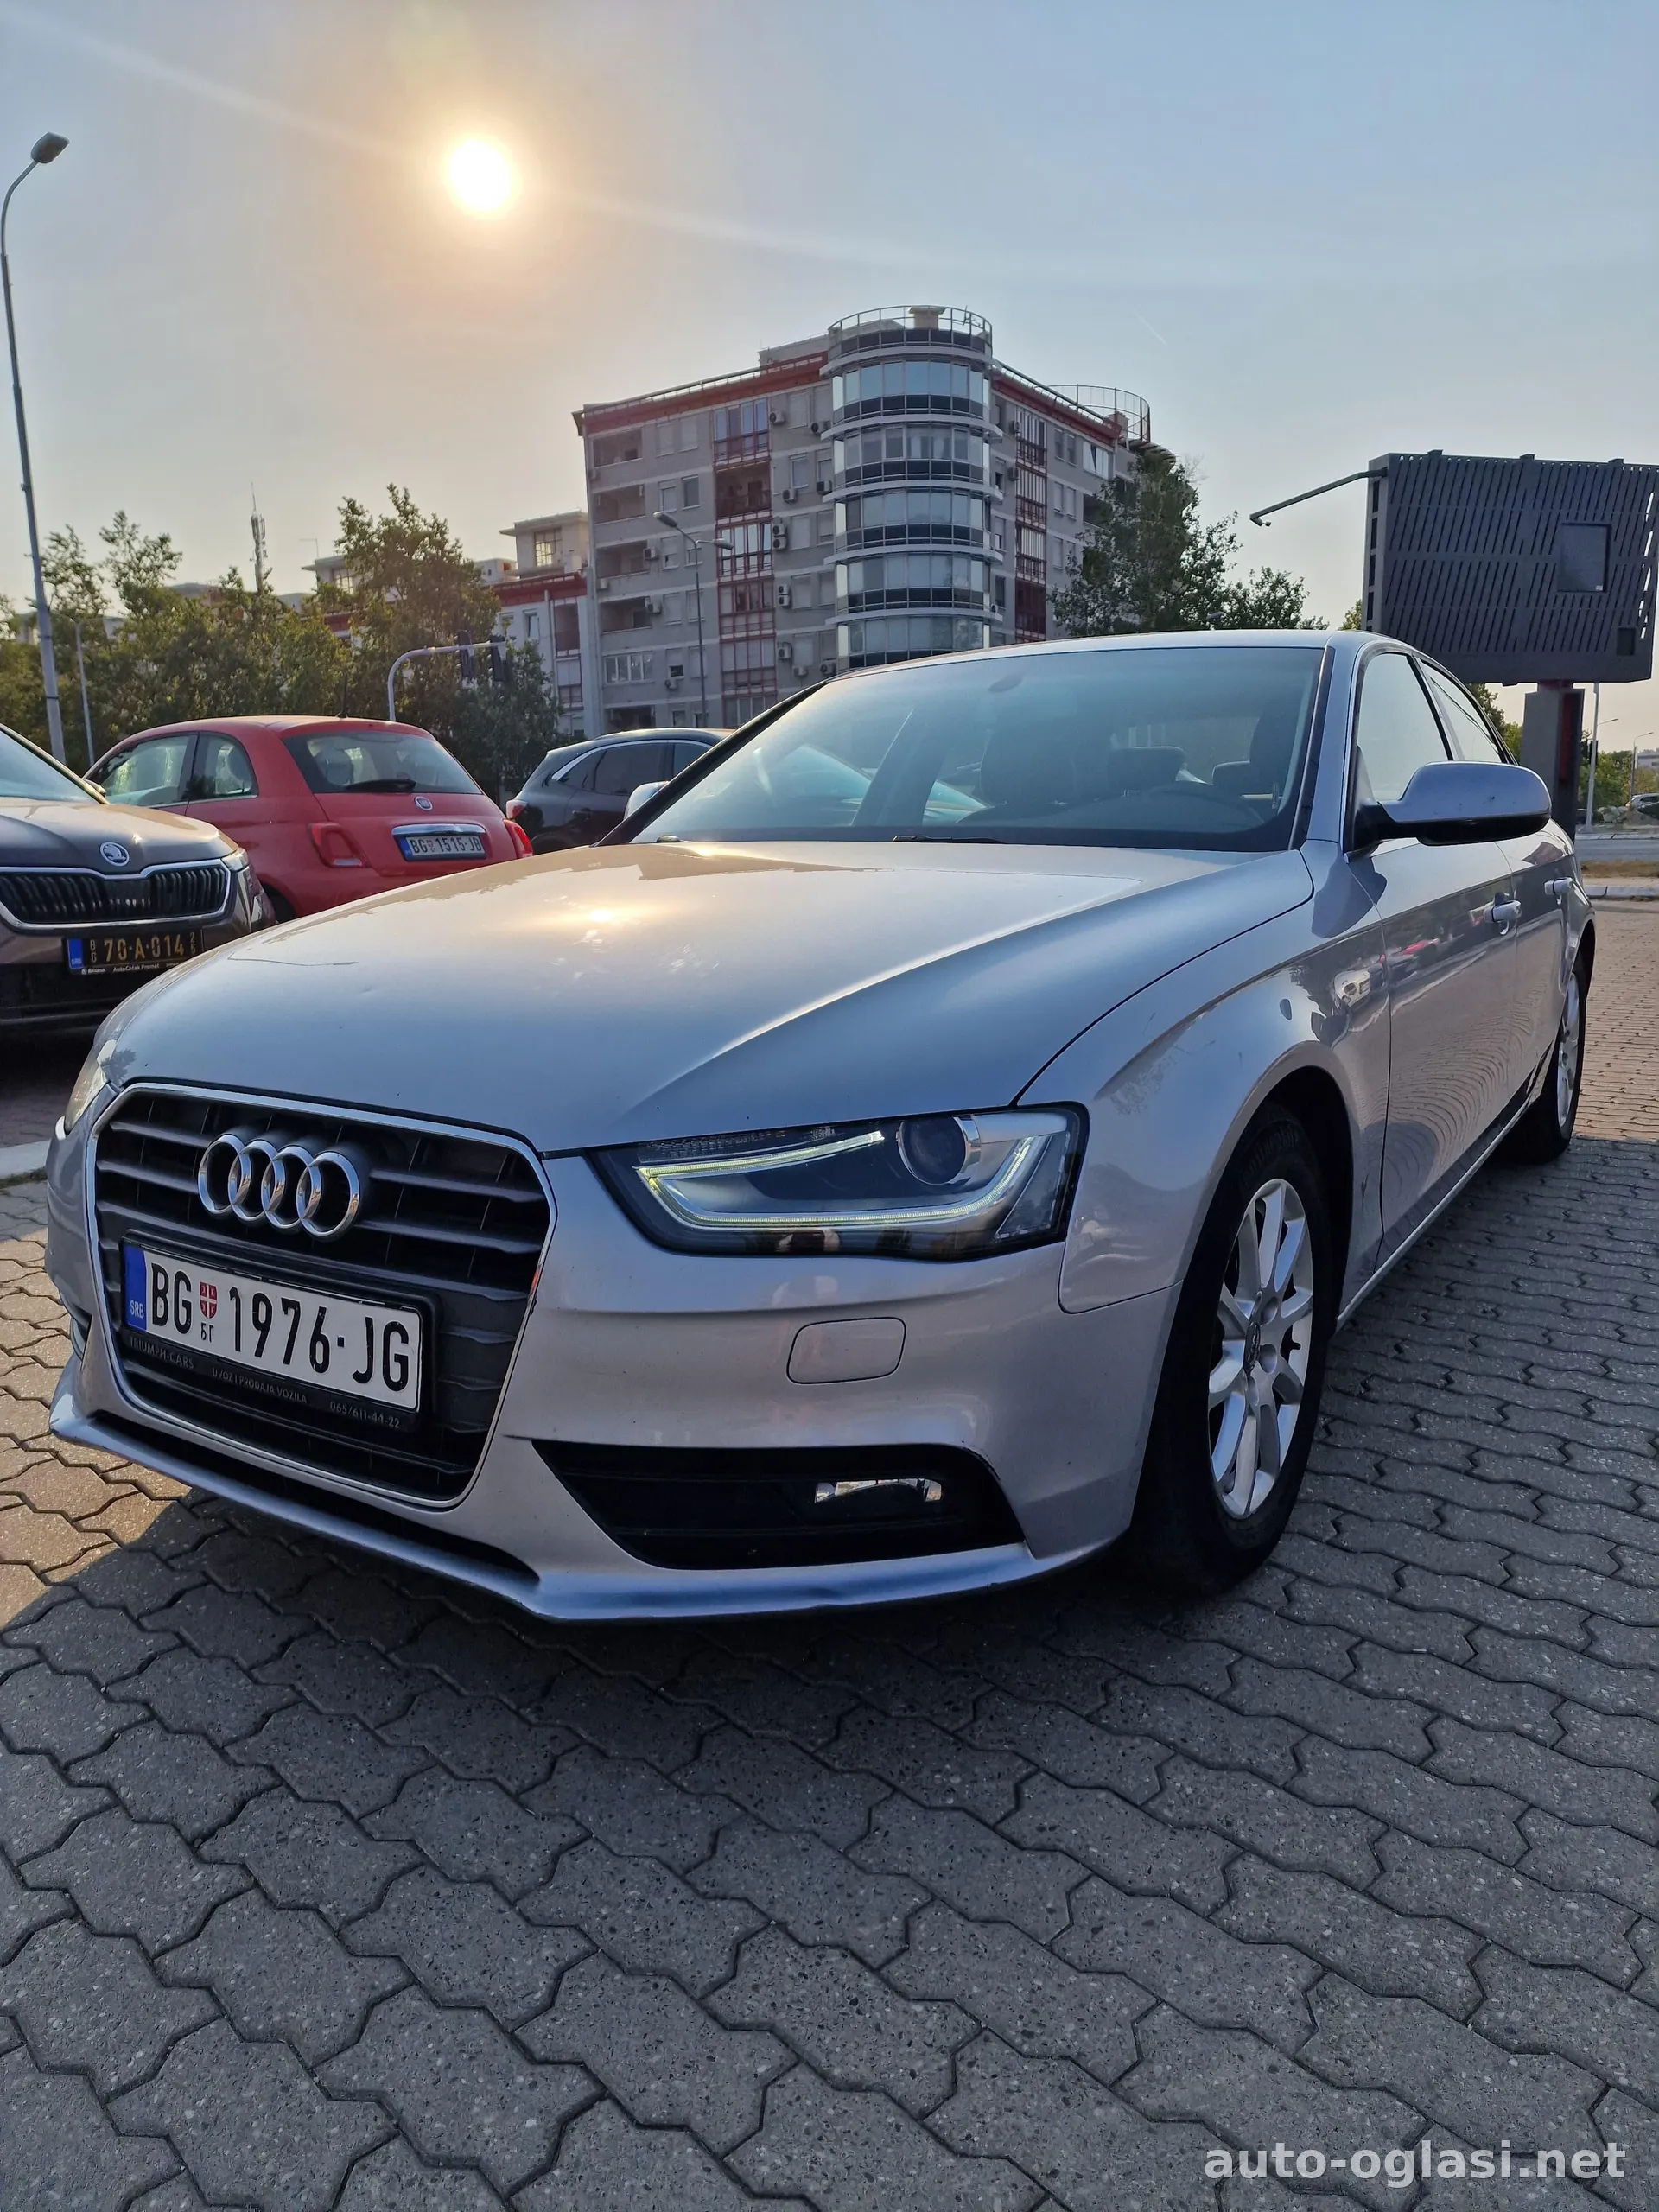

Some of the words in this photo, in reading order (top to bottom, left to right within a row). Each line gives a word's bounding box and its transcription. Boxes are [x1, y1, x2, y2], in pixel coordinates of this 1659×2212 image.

[410, 839, 428, 854] BG
[130, 1299, 144, 1319] SRB
[151, 1262, 193, 1335] BG
[130, 1337, 195, 1370] TRIUMPH-CARS
[212, 1367, 233, 1382] UVOZ
[239, 1375, 276, 1396] PRODAJA
[276, 1386, 308, 1403] VOZILA
